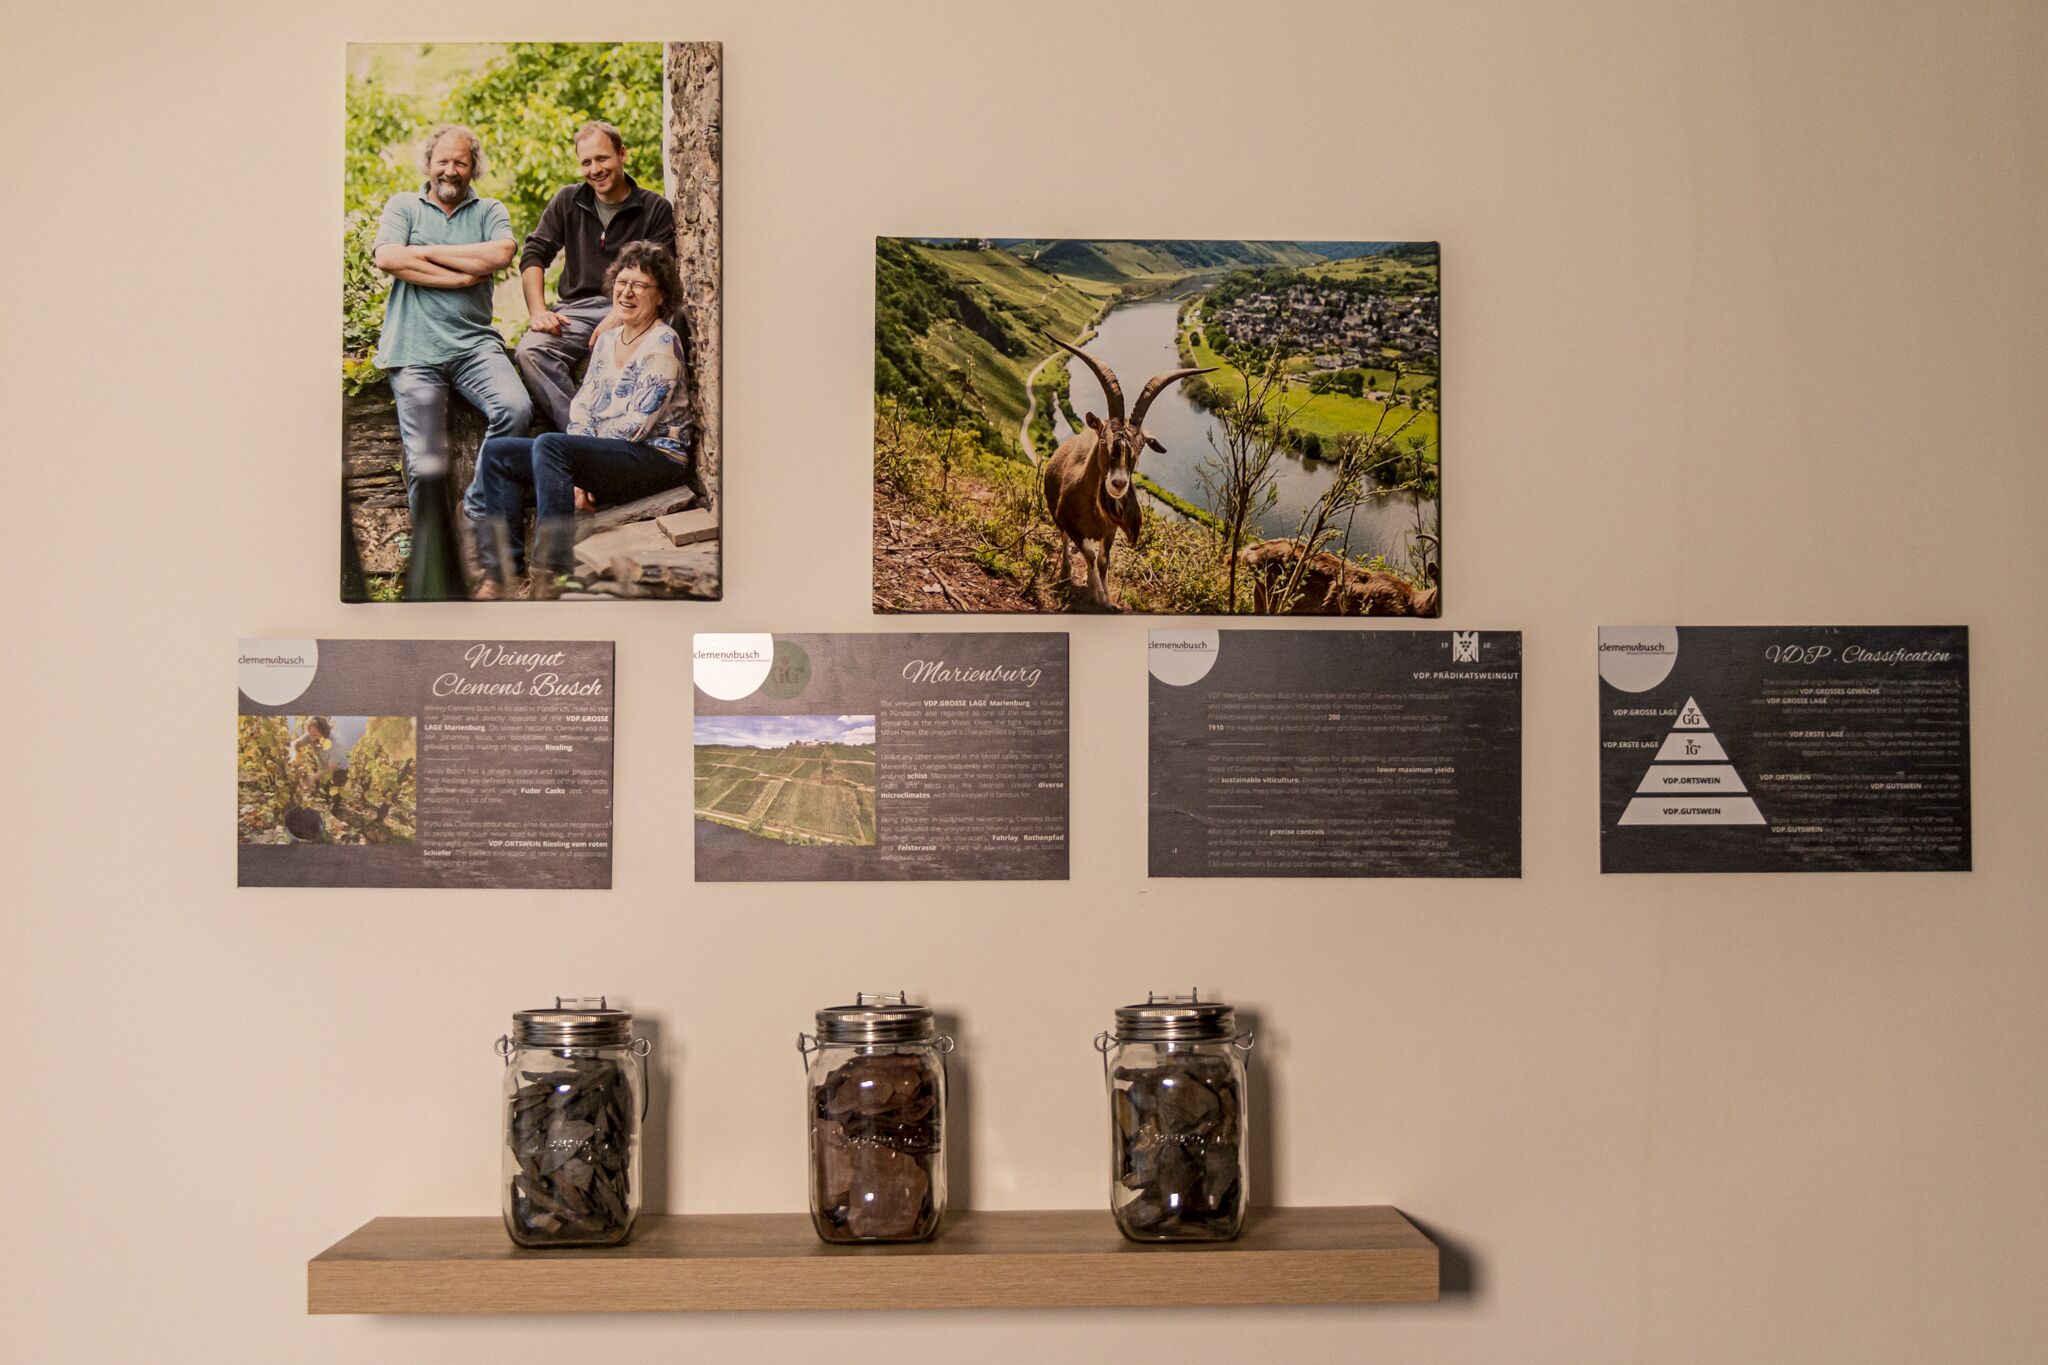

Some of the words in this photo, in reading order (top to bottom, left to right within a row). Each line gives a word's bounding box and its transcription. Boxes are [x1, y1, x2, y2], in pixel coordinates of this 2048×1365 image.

[464, 643, 566, 672] Weingut
[1841, 645, 1951, 667] Classification
[902, 659, 1042, 688] Marienburg
[432, 672, 526, 697] Clemens
[529, 672, 604, 697] Busch
[989, 700, 1031, 708] Marienburg
[1810, 697, 1829, 705] LAGE
[1376, 766, 1397, 774] lower
[1398, 766, 1433, 774] maximum
[1434, 766, 1455, 775] yields
[1270, 829, 1295, 837] precise
[1296, 828, 1325, 836] controls
[1023, 834, 1065, 843] Rothenpfad
[542, 840, 571, 849] Riesling
